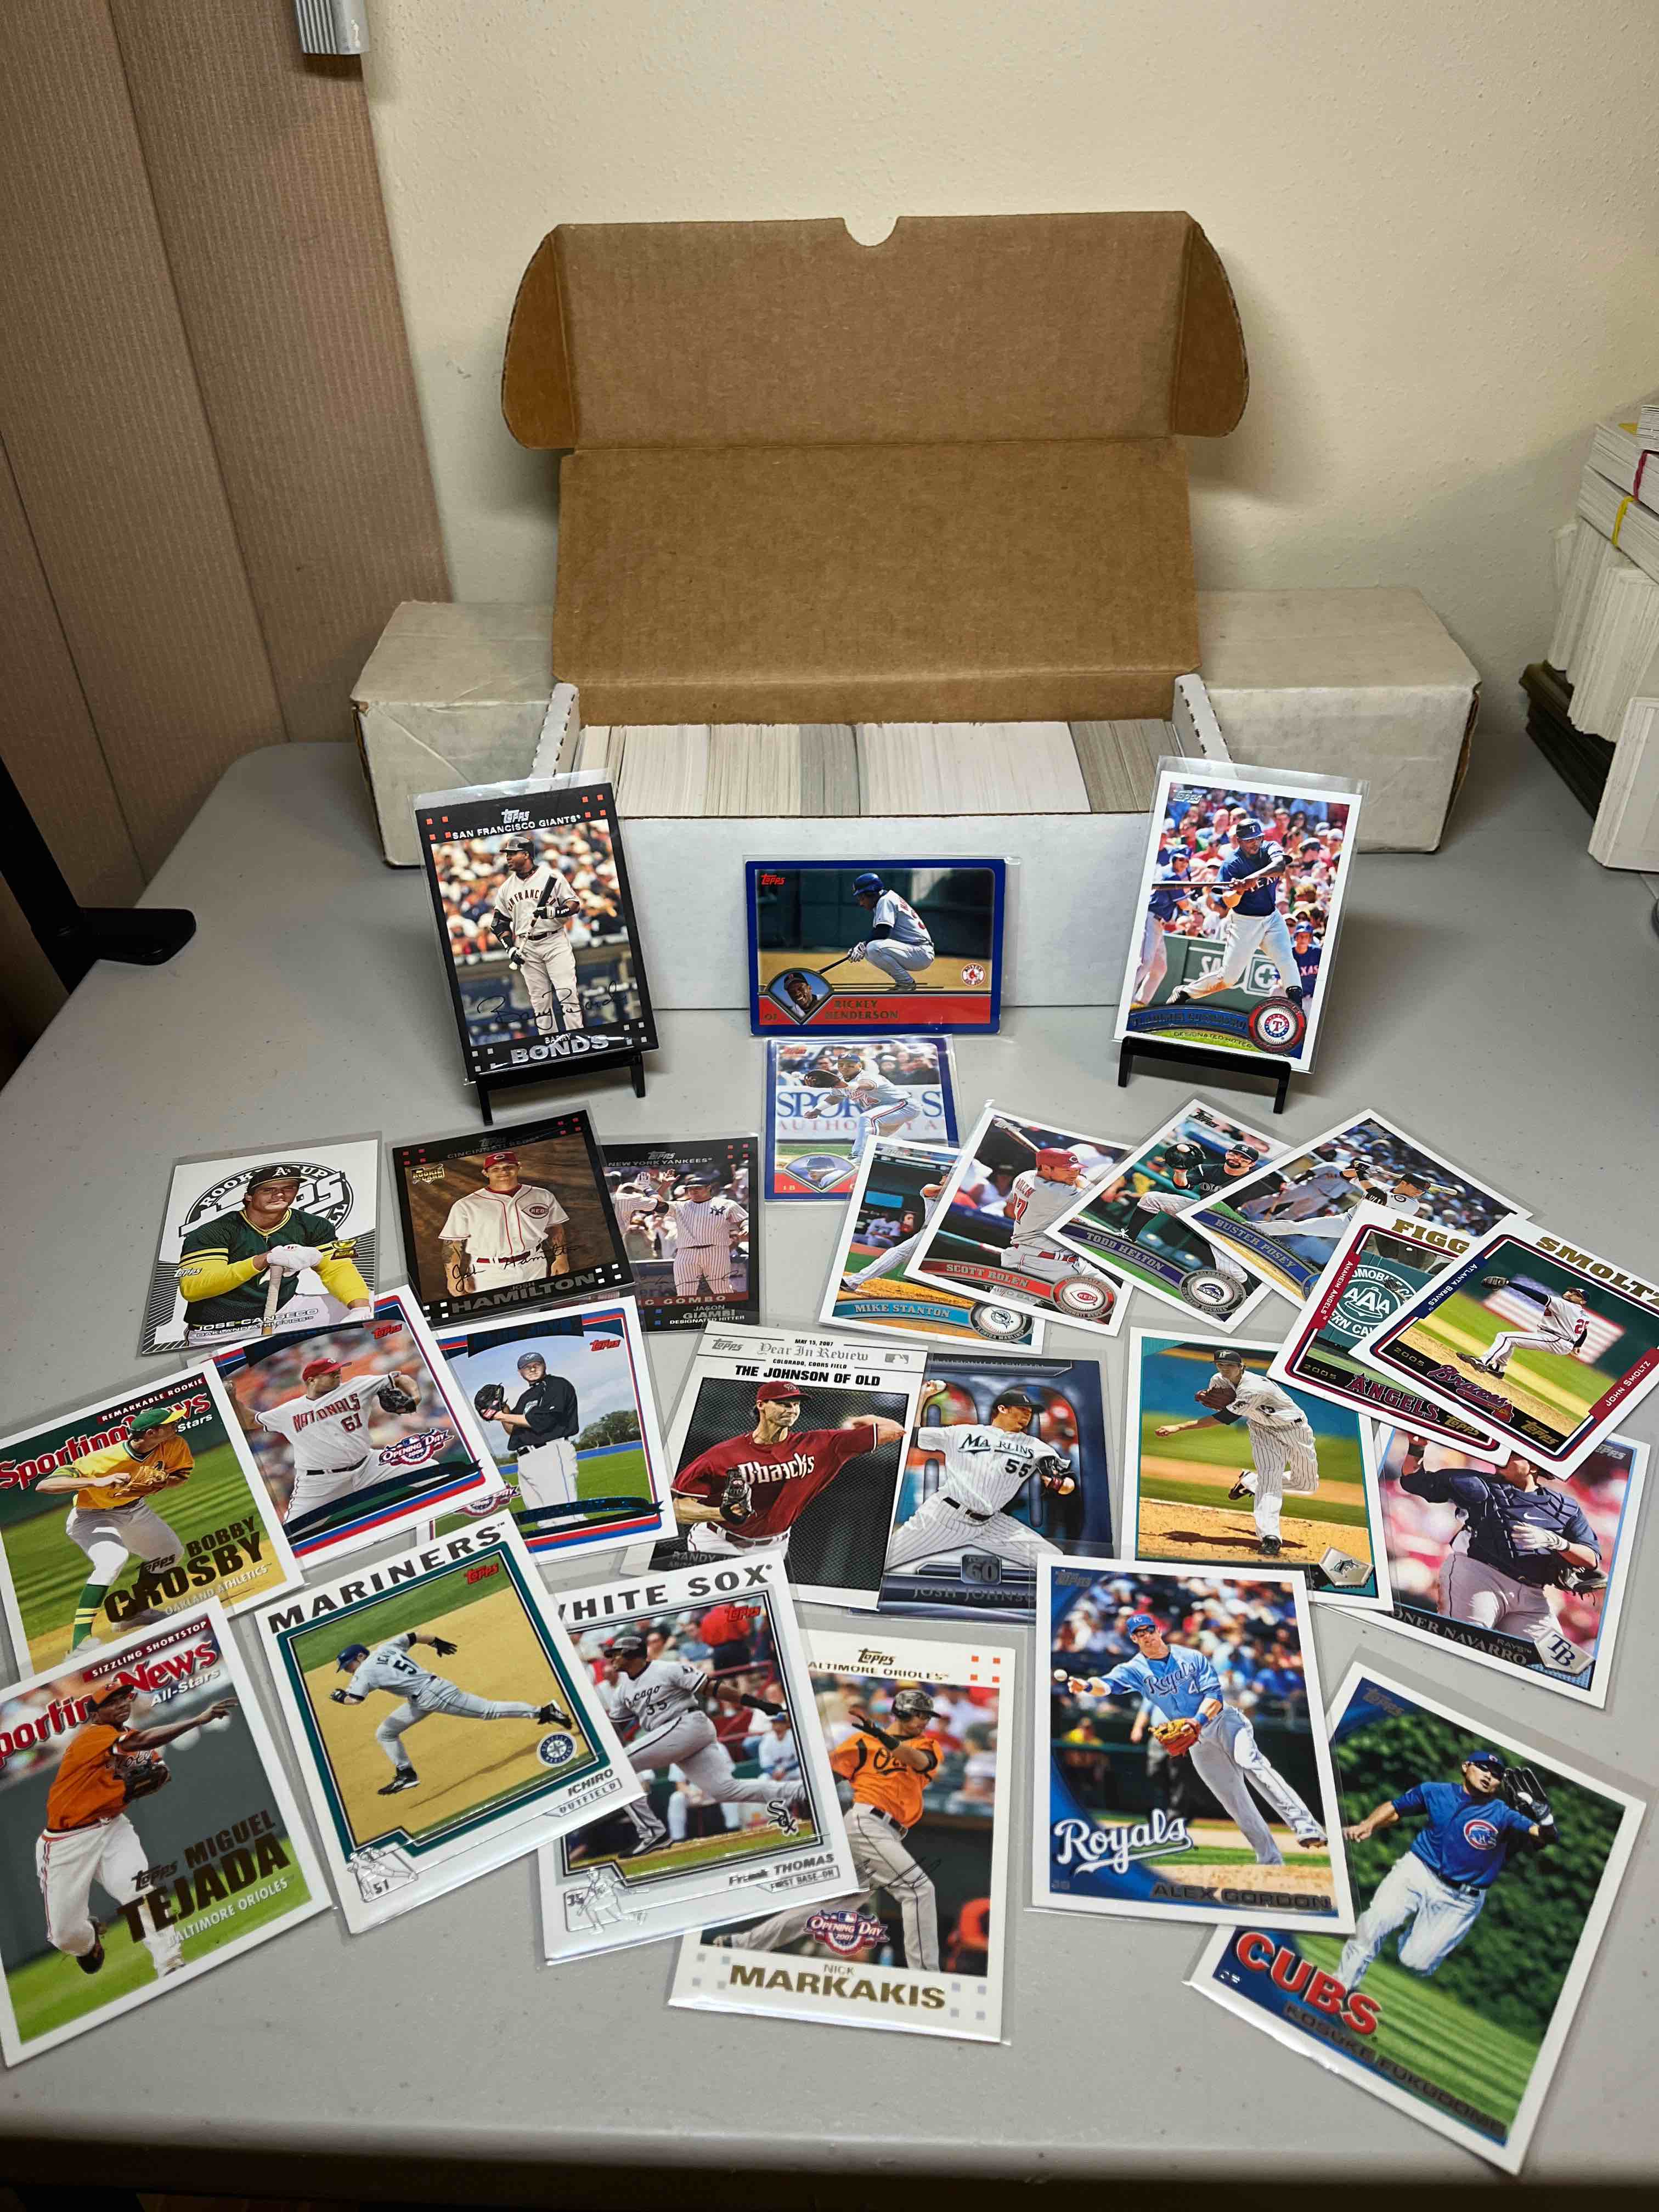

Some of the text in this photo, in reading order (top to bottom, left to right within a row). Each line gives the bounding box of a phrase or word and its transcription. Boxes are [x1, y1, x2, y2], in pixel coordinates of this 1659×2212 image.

[453, 815, 577, 839] SAN FRANCISCO GIANTS
[825, 1010, 899, 1020] HENDERSON
[834, 1000, 878, 1009] RICKEY
[510, 1035, 609, 1064] BONDS
[1215, 1217, 1260, 1248] BUSTER
[1391, 1218, 1470, 1254] FIGG
[1086, 1231, 1165, 1271] TODD HELTON
[946, 1263, 1030, 1288] SCOTT ROLEN
[1321, 1261, 1353, 1314] ANAHEIM ANGELS
[1451, 1263, 1478, 1286] ATLANTA
[452, 1273, 596, 1313] HAMILTON
[1427, 1285, 1453, 1306] BRAVES
[194, 1308, 319, 1332] JOSE CANSECO
[682, 1309, 736, 1320] GIAMBI
[854, 1304, 951, 1318] MIKE STANTON
[757, 1342, 869, 1361] Year In Review
[1393, 1346, 1426, 1367] 2005
[735, 1364, 881, 1386] THE JOHNSON OF OLD
[1302, 1363, 1338, 1380] 2005
[1605, 1360, 1651, 1407] JOHN SMOLTZ
[101, 1394, 165, 1422] REMARKABLE
[167, 1378, 205, 1397] ROOKIE
[1345, 1372, 1440, 1422] ANGELS
[341, 1412, 363, 1434] 61
[1005, 1458, 1032, 1477] 55
[186, 1516, 256, 1555] BOBBY
[104, 1533, 264, 1623] CROSBY
[267, 1525, 504, 1635] MARINERS
[558, 1564, 769, 1622] HITE SOX
[963, 1587, 1037, 1602] JOHNSO
[91, 1621, 208, 1678] SIZZLING SHORTSTOP
[1390, 1606, 1528, 1667] ONER NAVARRO
[806, 1661, 878, 1674] ALTIMORE
[150, 1669, 221, 1709] All-Stars
[559, 1782, 616, 1813] OUTFIELD
[568, 1768, 614, 1797] ICHIRO
[184, 1809, 276, 1868] MIGUEL
[1053, 1809, 1193, 1876] Royals
[774, 1853, 834, 1875] THOMAS
[116, 1832, 291, 1944] TEJADA
[238, 1878, 289, 1912] ORIOLES
[1153, 1882, 1333, 1911] ALEX GORDON
[823, 1963, 855, 1976] NICK
[1235, 1931, 1383, 2035] CUBS
[727, 1964, 946, 2011] MARKAKIS
